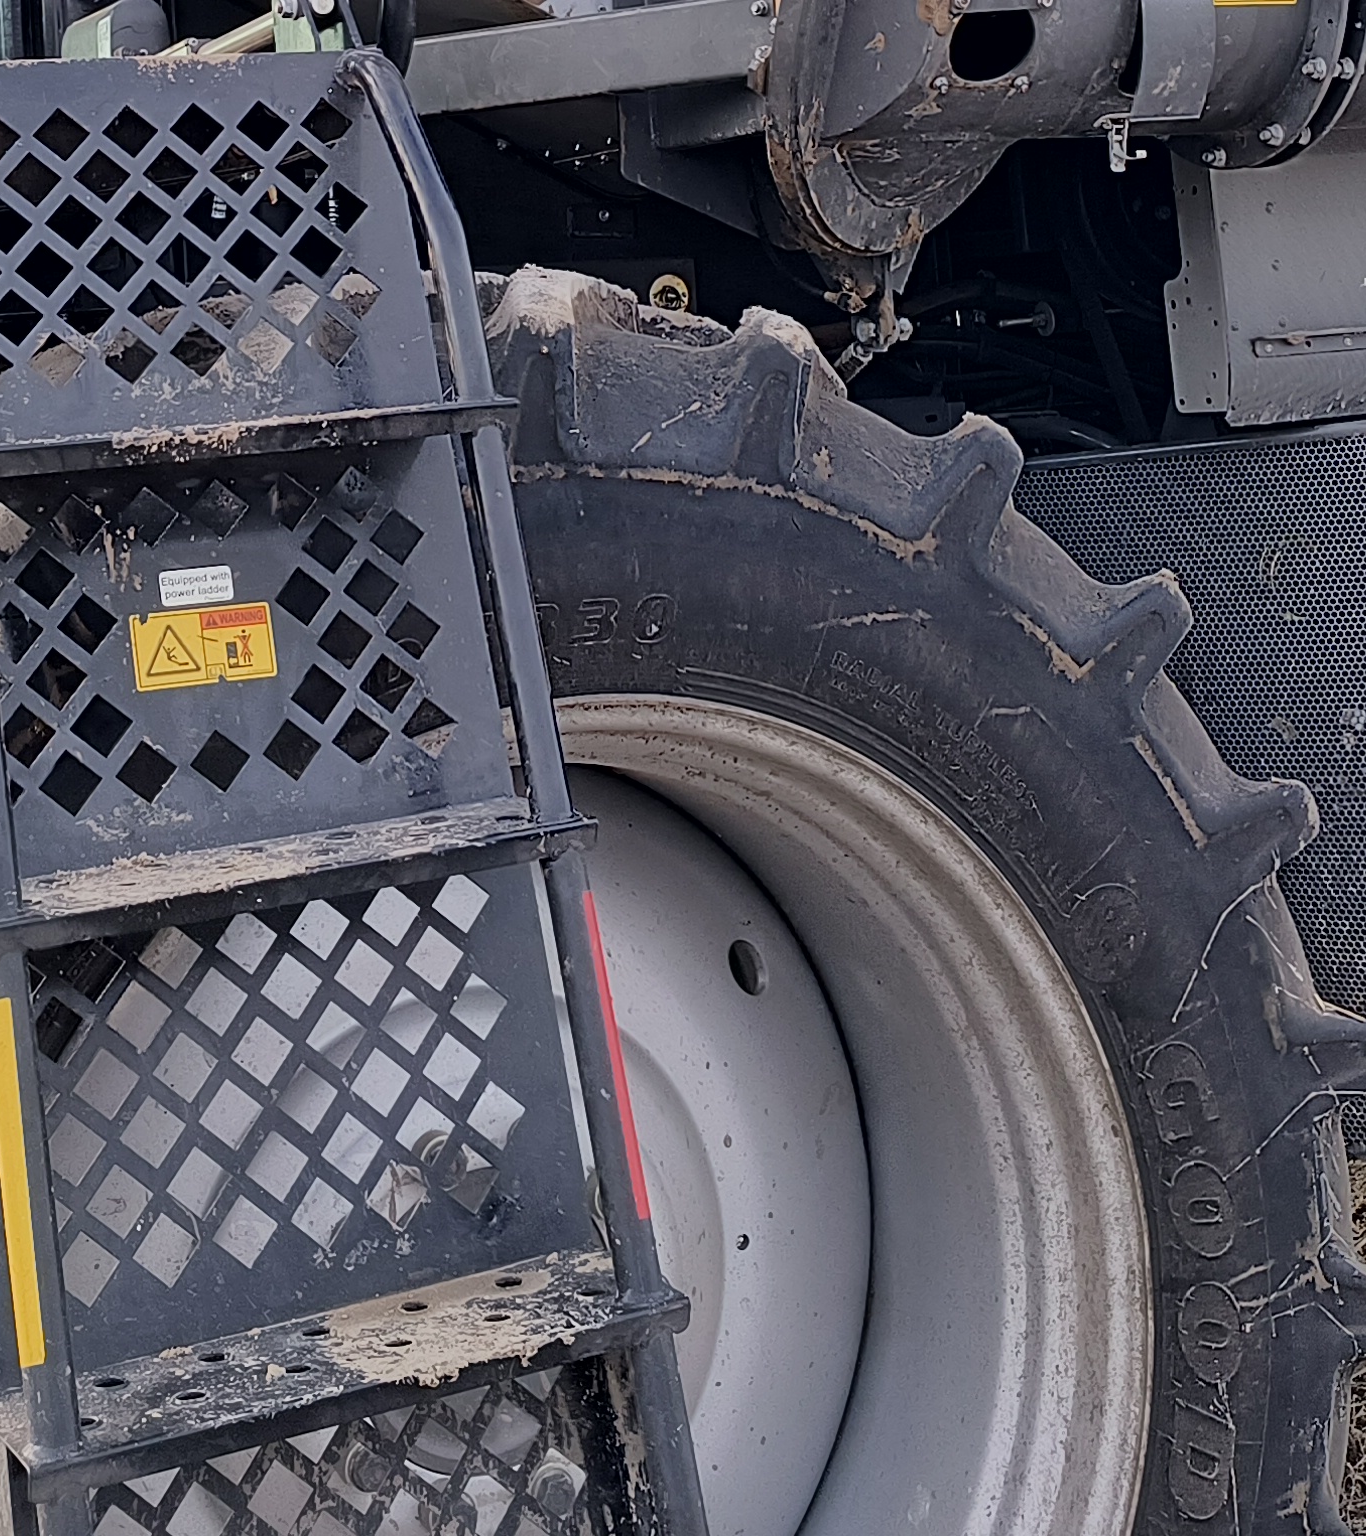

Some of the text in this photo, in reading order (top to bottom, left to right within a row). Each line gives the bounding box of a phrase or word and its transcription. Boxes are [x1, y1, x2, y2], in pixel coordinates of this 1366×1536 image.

[160, 571, 231, 588] Equipped with
[164, 588, 196, 601] power
[198, 583, 230, 596] ladder
[218, 609, 264, 625] WARNING
